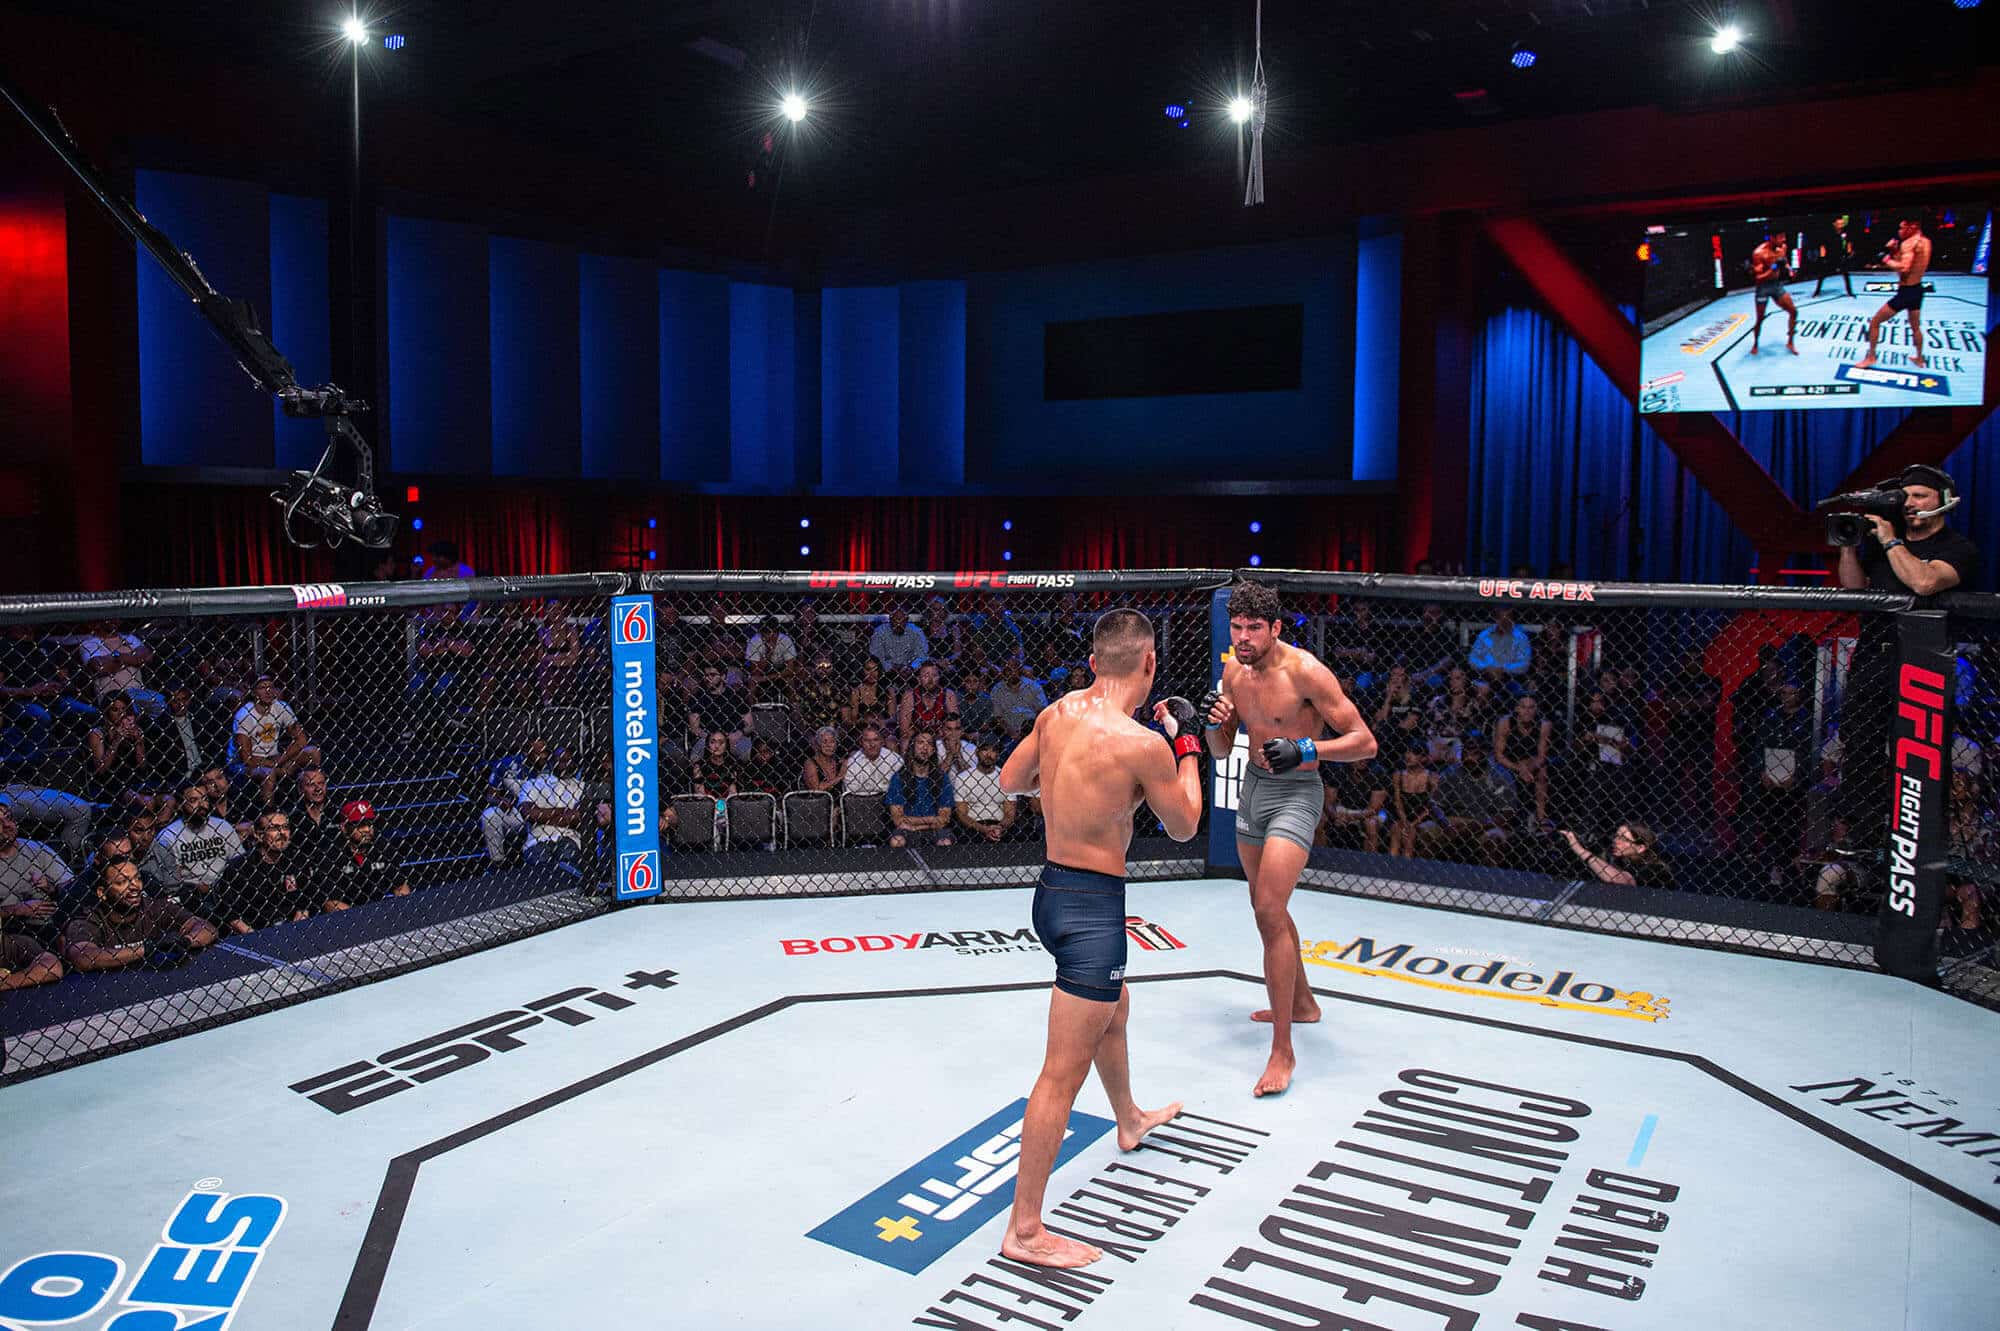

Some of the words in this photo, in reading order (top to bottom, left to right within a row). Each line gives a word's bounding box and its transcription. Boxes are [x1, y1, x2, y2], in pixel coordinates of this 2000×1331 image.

[1927, 328, 1988, 353] SER
[348, 596, 386, 606] SPORTS
[808, 571, 865, 588] UFC
[953, 571, 1008, 588] UFC
[1479, 579, 1523, 598] UFC
[1529, 582, 1595, 601] APEX
[1896, 663, 1945, 781] UFC
[624, 661, 652, 835] motel6.com
[779, 928, 1041, 956] BODYARM
[955, 945, 1043, 956] Sports
[1336, 937, 1617, 1003] Modelo
[1130, 1111, 1271, 1175] LIVE
[1788, 1077, 2000, 1184] NEM
[1042, 1162, 1212, 1263] EVERY
[1537, 1168, 1681, 1301] DANA
